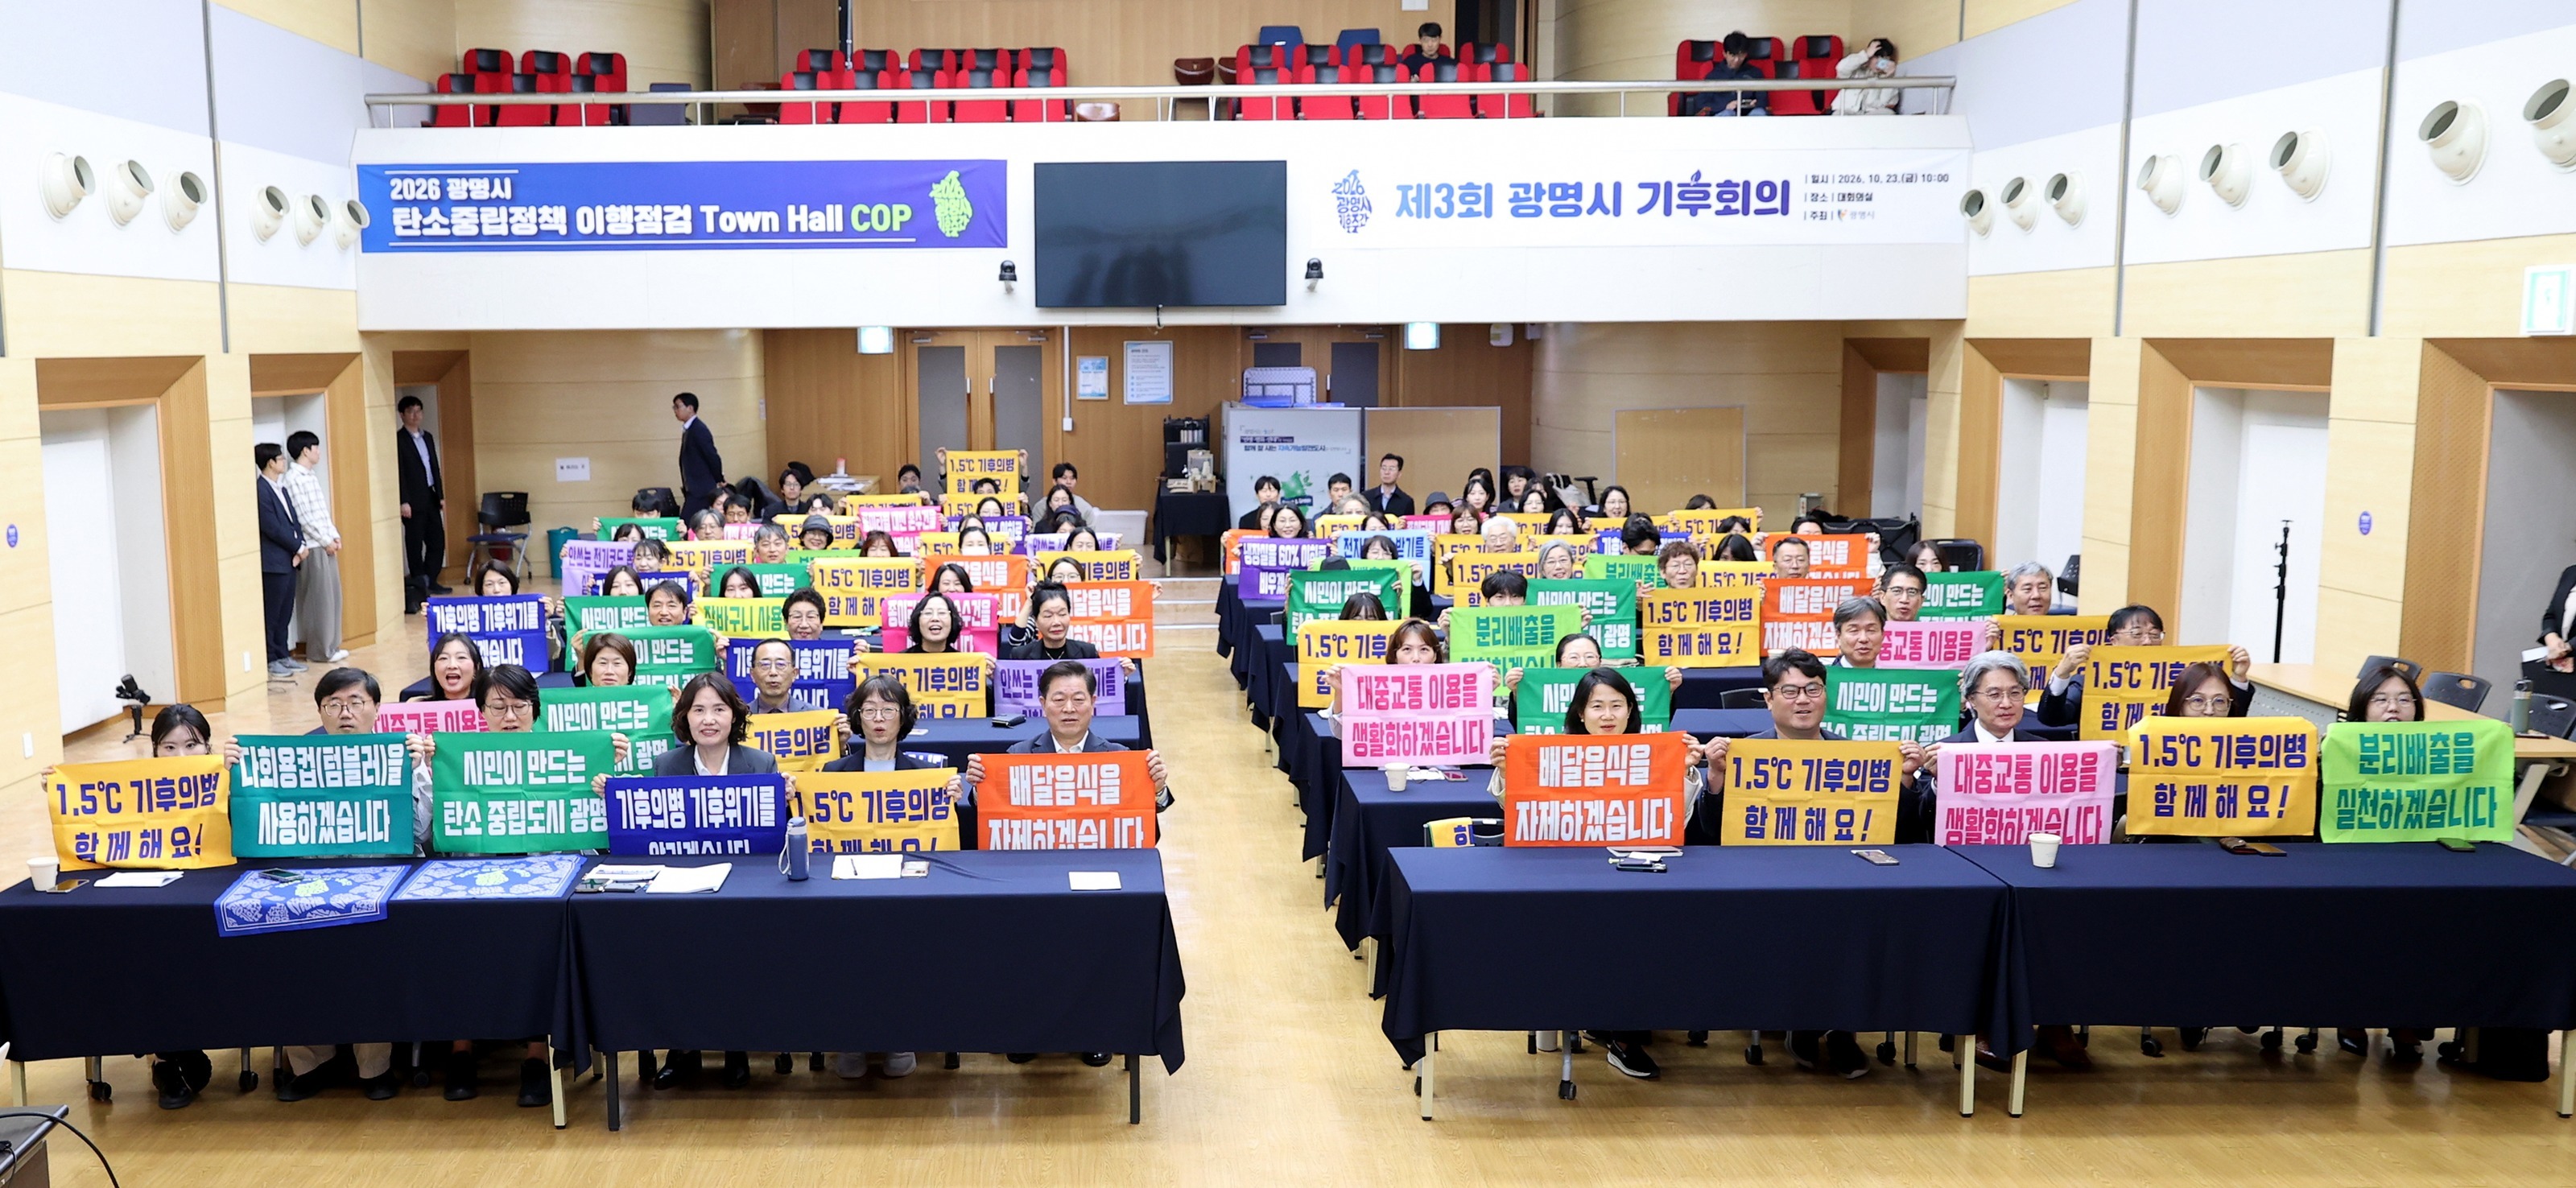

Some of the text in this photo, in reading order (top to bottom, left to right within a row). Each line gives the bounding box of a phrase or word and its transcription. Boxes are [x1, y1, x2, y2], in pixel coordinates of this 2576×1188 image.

[390, 176, 512, 200] 2026 광명시
[1838, 174, 1865, 184] 2026.
[1868, 174, 1883, 184] 10.
[1922, 173, 1950, 183] 10:00
[1336, 196, 1372, 214] 광명시
[1395, 171, 1790, 219] 제3회 광명시 기후회의
[391, 204, 913, 237] 탄소중립정책 이행점검 Town Hall COP
[978, 458, 1014, 472] 기후의병
[1278, 543, 1300, 567] 60%
[1807, 540, 1849, 565] 음식을
[762, 573, 795, 594] 만드는
[858, 567, 910, 588] 기후의병
[1304, 580, 1342, 604] 시민이
[1070, 588, 1130, 617] 달음식을
[1693, 598, 1752, 622] 기후의병
[1946, 584, 1984, 607] 만드는
[432, 600, 539, 633] 기후의병 기후위기를
[581, 606, 651, 631] 시민이 만드
[704, 605, 754, 633] 장바구니
[1476, 614, 1555, 647] 분리배출을
[651, 638, 694, 664] 만드는
[1067, 622, 1147, 653] 하겠습니다
[1604, 624, 1631, 648] 광명
[1763, 621, 1837, 650] 자제하겠습
[1878, 630, 1973, 662] 중교통 이용을
[913, 666, 980, 692] 기후의병
[1000, 667, 1034, 699] 안쓰는
[1357, 673, 1478, 710] 대중교통 이용을
[1836, 681, 1938, 713] 시민이 만드는
[547, 700, 649, 732] 시민이 만드는
[754, 726, 831, 758] 기후의병
[1352, 719, 1484, 757] 생활화하겠습니다
[2211, 733, 2307, 769] 기후의병
[2358, 732, 2475, 775] 분리배출을
[240, 743, 405, 790] 다회용컵(텀블러)을
[463, 749, 523, 786] 시민이
[527, 749, 586, 784] 만드는
[1538, 744, 1651, 788] 배달음식을
[1803, 756, 1892, 794] 기후의병
[1954, 751, 2099, 795] 대중교통 이용을
[130, 772, 221, 814] 기후의병
[1009, 763, 1121, 806] 배달음식을
[444, 798, 608, 837] 탄소 중립도시 광명
[615, 785, 776, 830] 기후의병 기후위기를
[861, 787, 951, 823] 기후의병
[1515, 797, 1674, 844] 자제하겠습니다
[2334, 786, 2499, 830] 실천하겠습니다
[258, 798, 390, 846] 사용하겠습니다
[988, 815, 1145, 849] 자제하겠습니다
[1945, 805, 2103, 845] 생활화하겠습니다
